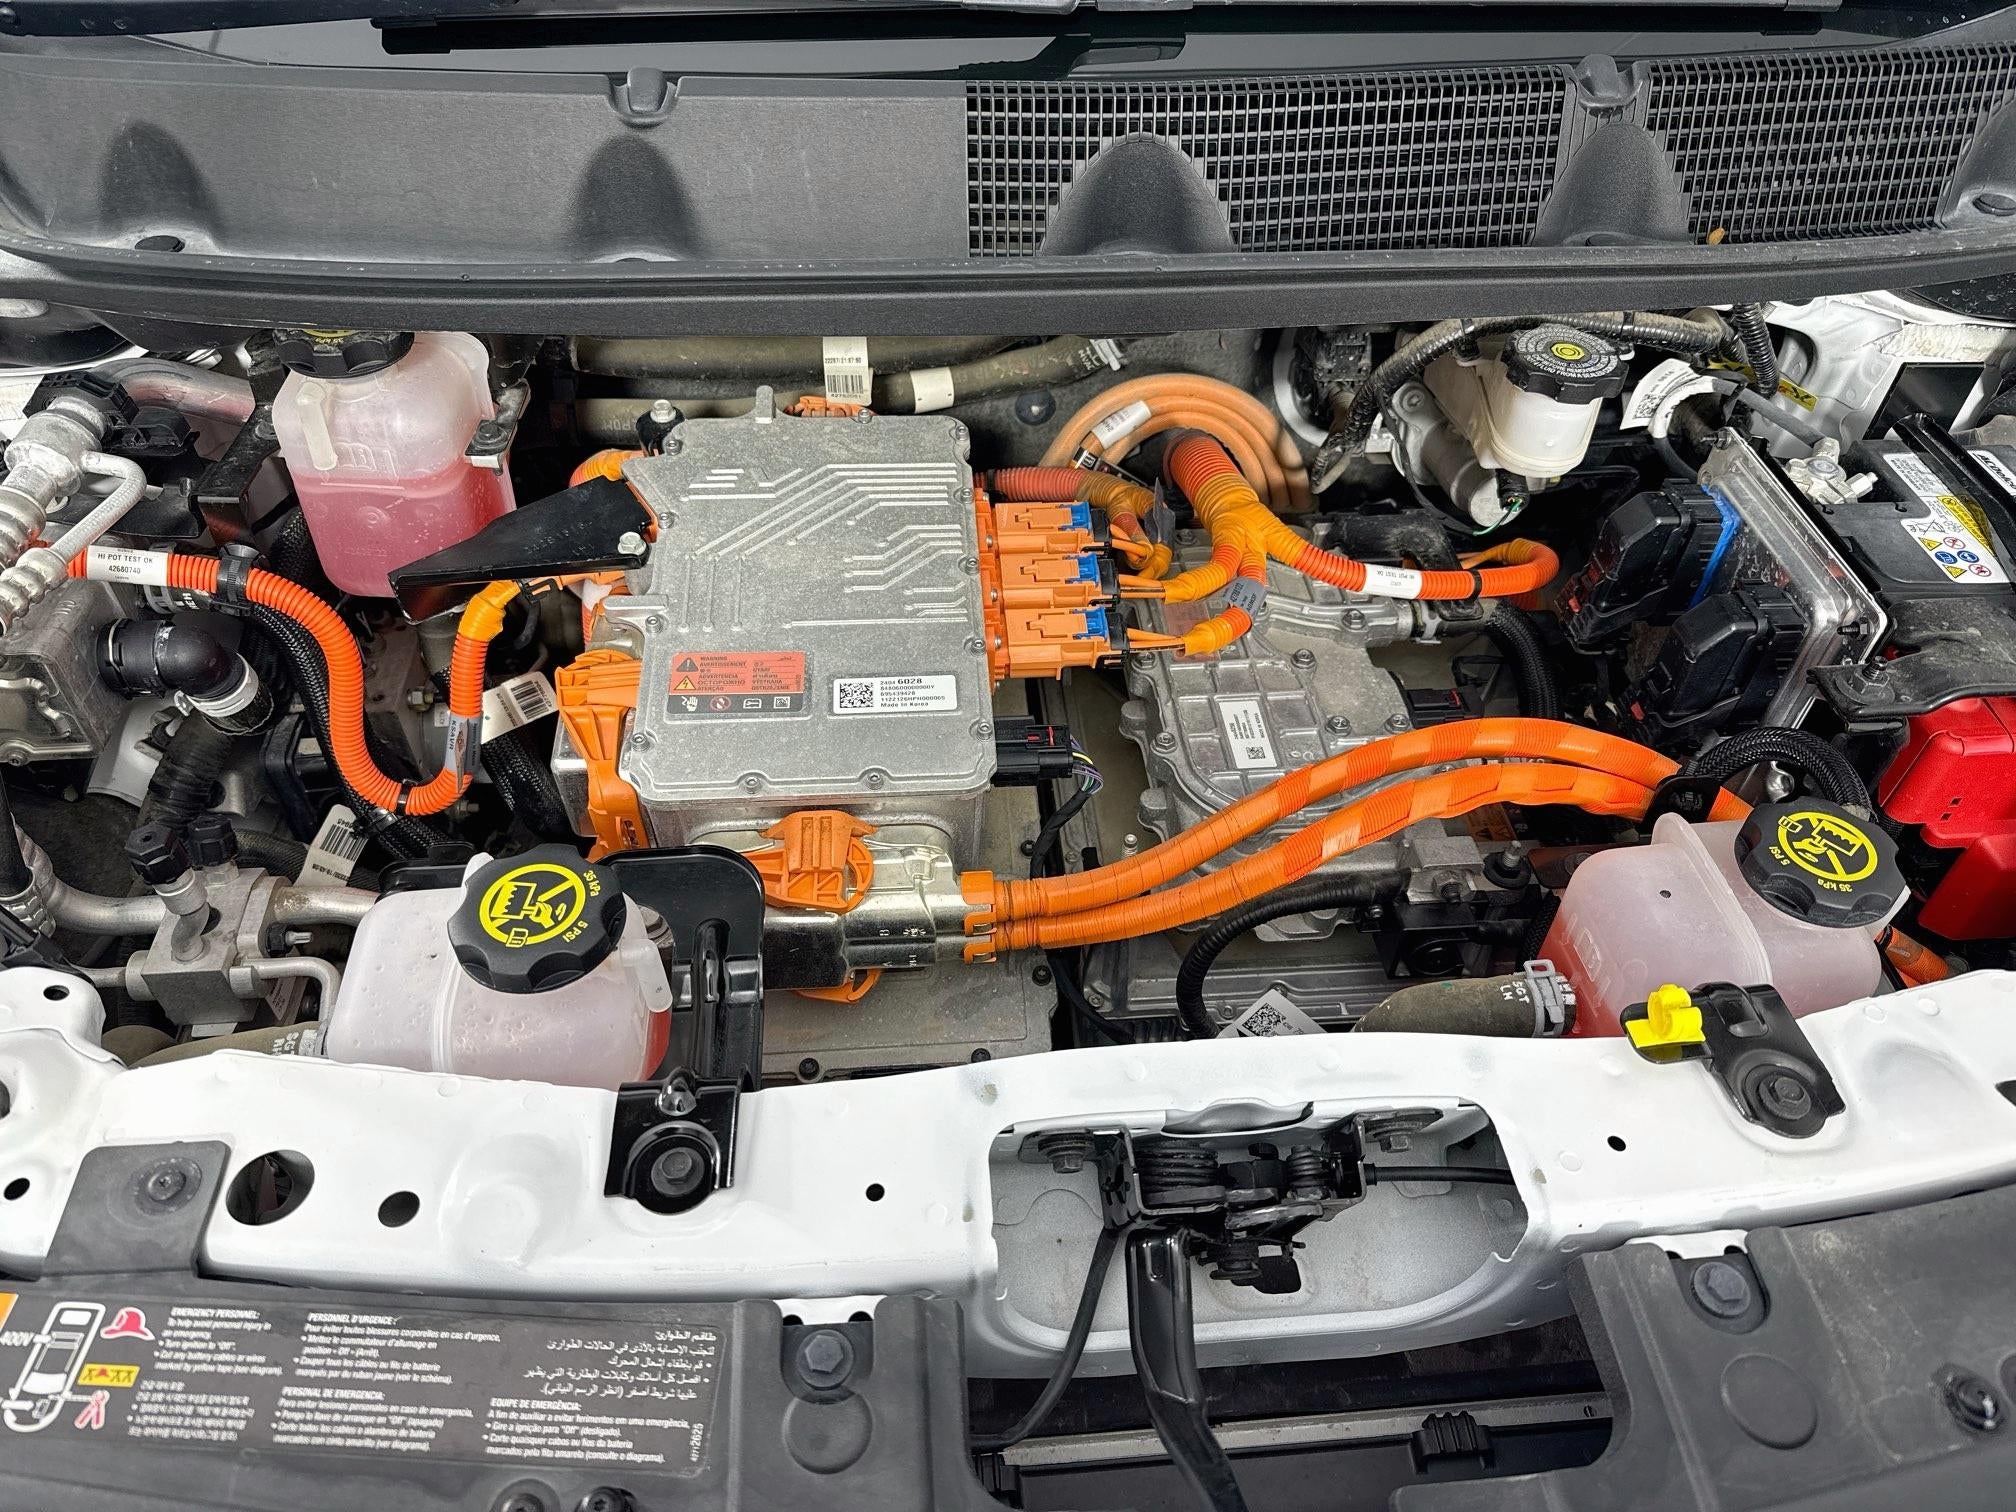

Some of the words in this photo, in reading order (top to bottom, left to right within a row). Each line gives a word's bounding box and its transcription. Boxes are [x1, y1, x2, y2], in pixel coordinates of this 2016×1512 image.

[109, 565, 140, 574] 42680740
[1769, 846, 1784, 859] PSI
[584, 870, 597, 881] 35
[588, 880, 601, 896] kPa
[1817, 878, 1837, 891] kPa
[1839, 883, 1853, 892] 35
[562, 927, 582, 942] PSI
[307, 1312, 350, 1323] PERSONNEL
[304, 1323, 321, 1332] Pour
[343, 1325, 365, 1334] toutes
[366, 1326, 400, 1336] blessures
[400, 1329, 439, 1338] corporelles
[490, 1397, 518, 1407] EQUIPE
[519, 1399, 530, 1408] DE
